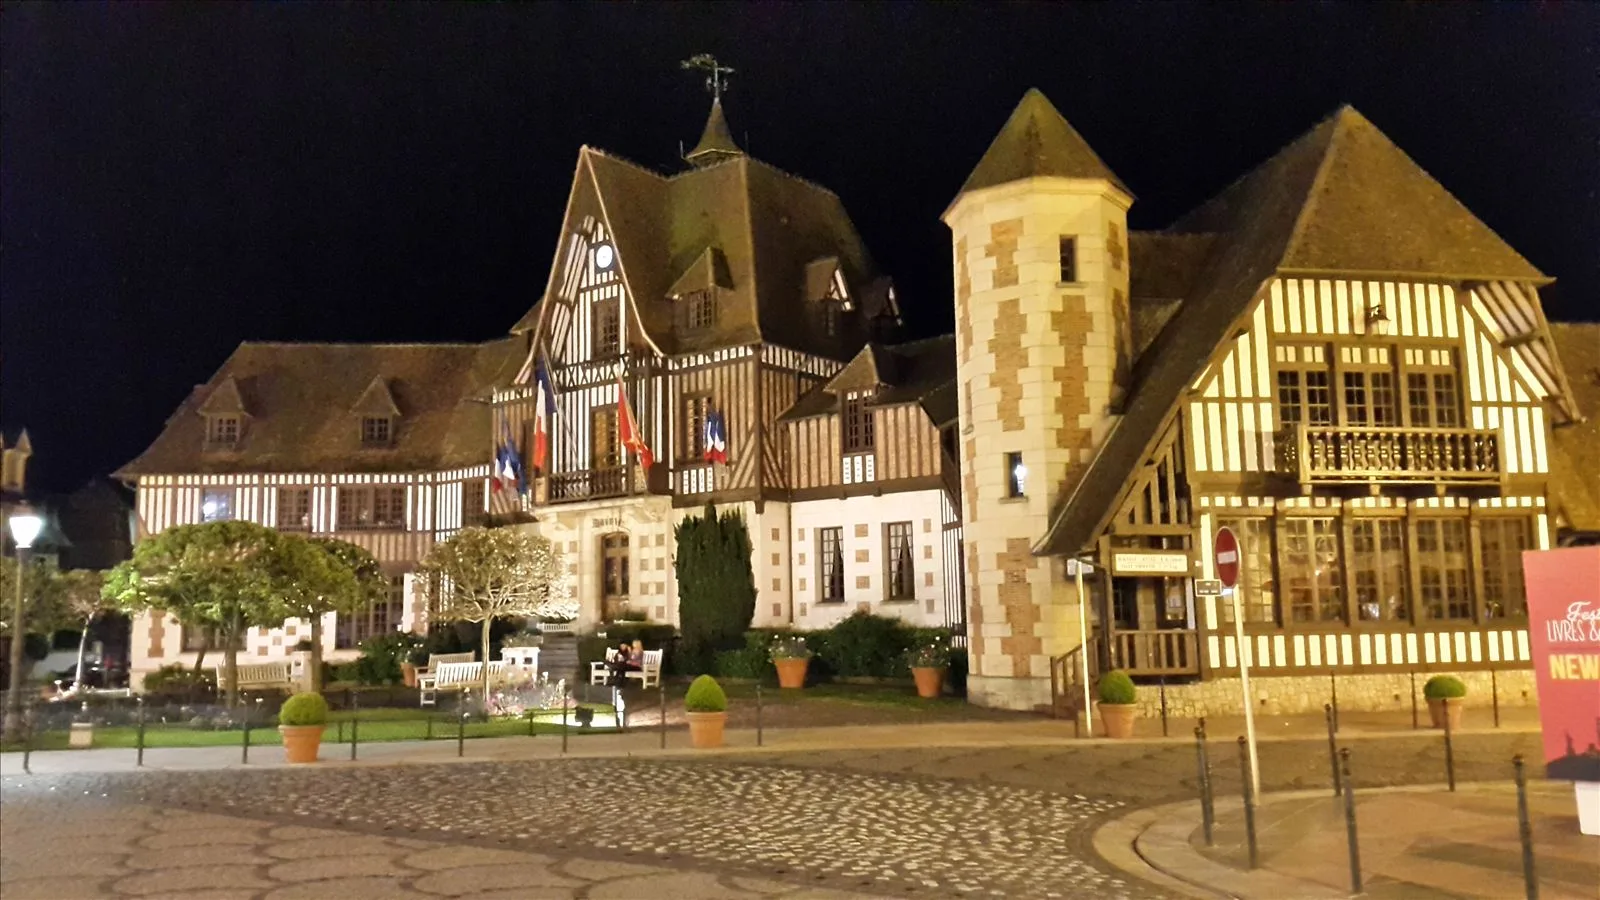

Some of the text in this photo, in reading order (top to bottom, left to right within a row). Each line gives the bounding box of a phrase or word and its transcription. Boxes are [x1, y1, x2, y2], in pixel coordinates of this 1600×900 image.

[1547, 618, 1600, 642] LIVRES &
[1549, 654, 1600, 679] NEW
